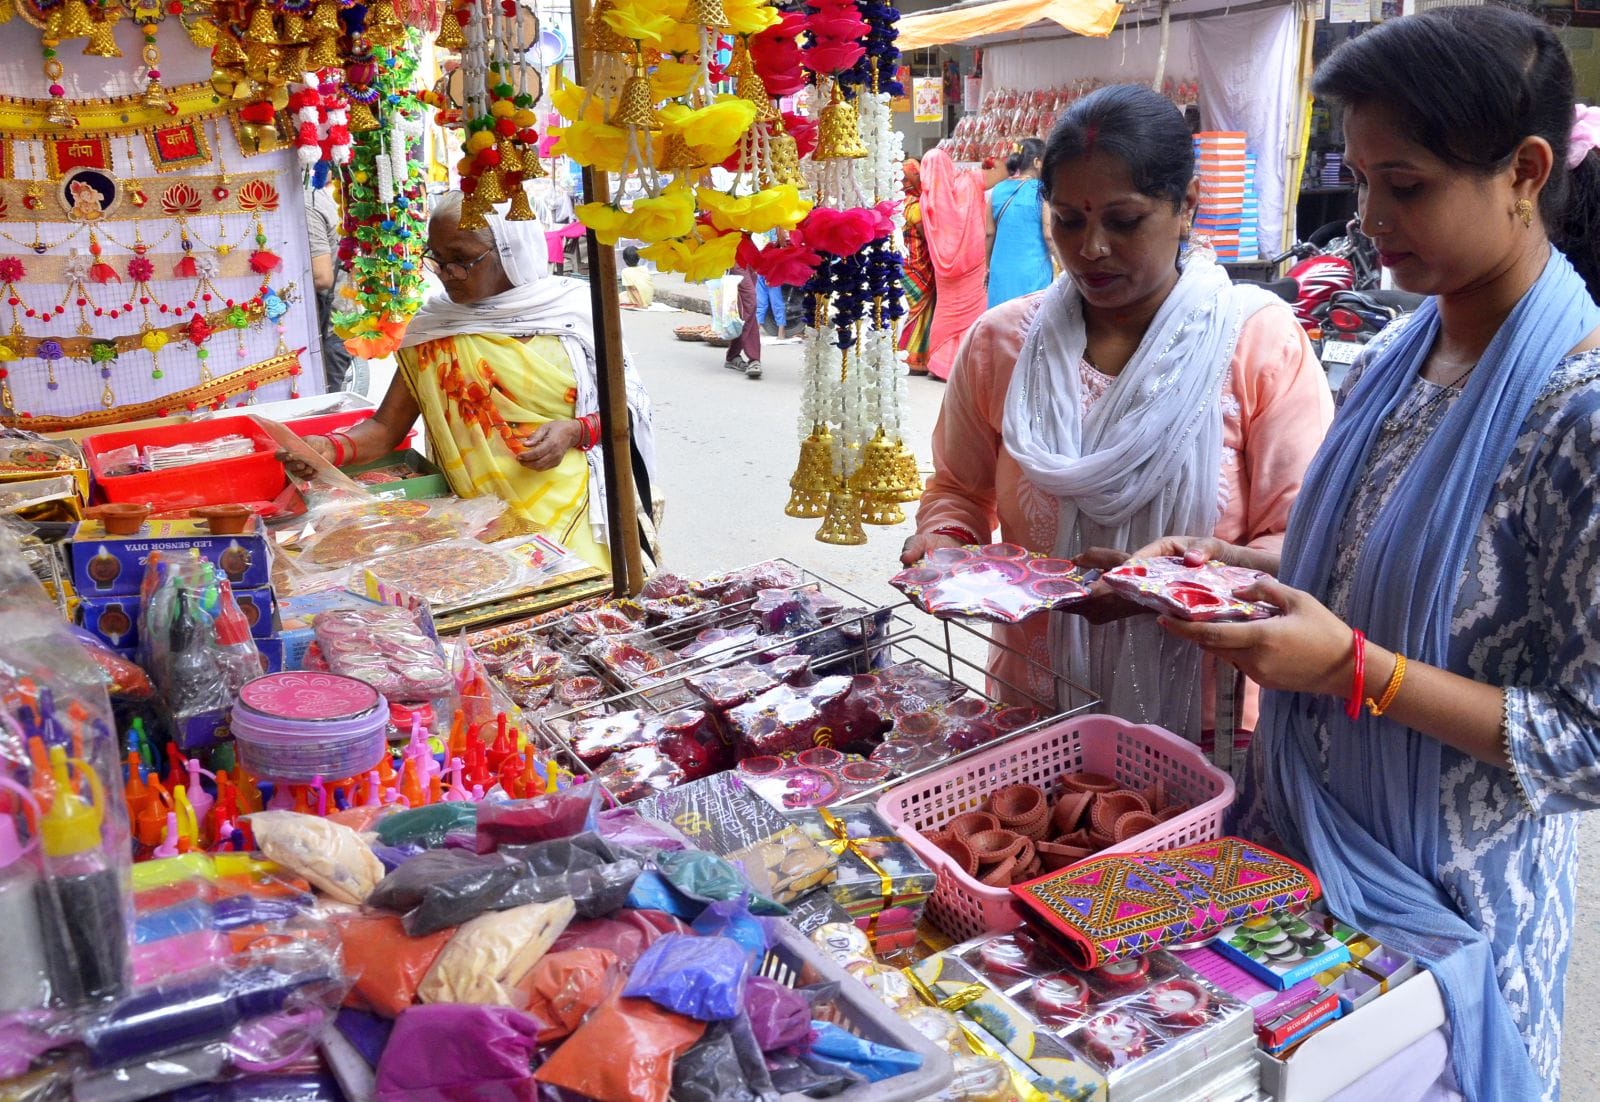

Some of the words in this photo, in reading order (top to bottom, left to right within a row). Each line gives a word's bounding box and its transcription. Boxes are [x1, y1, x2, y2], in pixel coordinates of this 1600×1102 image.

[68, 143, 93, 157] दीपा
[124, 543, 149, 552] DIYA
[151, 541, 191, 550] SENSOR
[193, 540, 213, 548] LED
